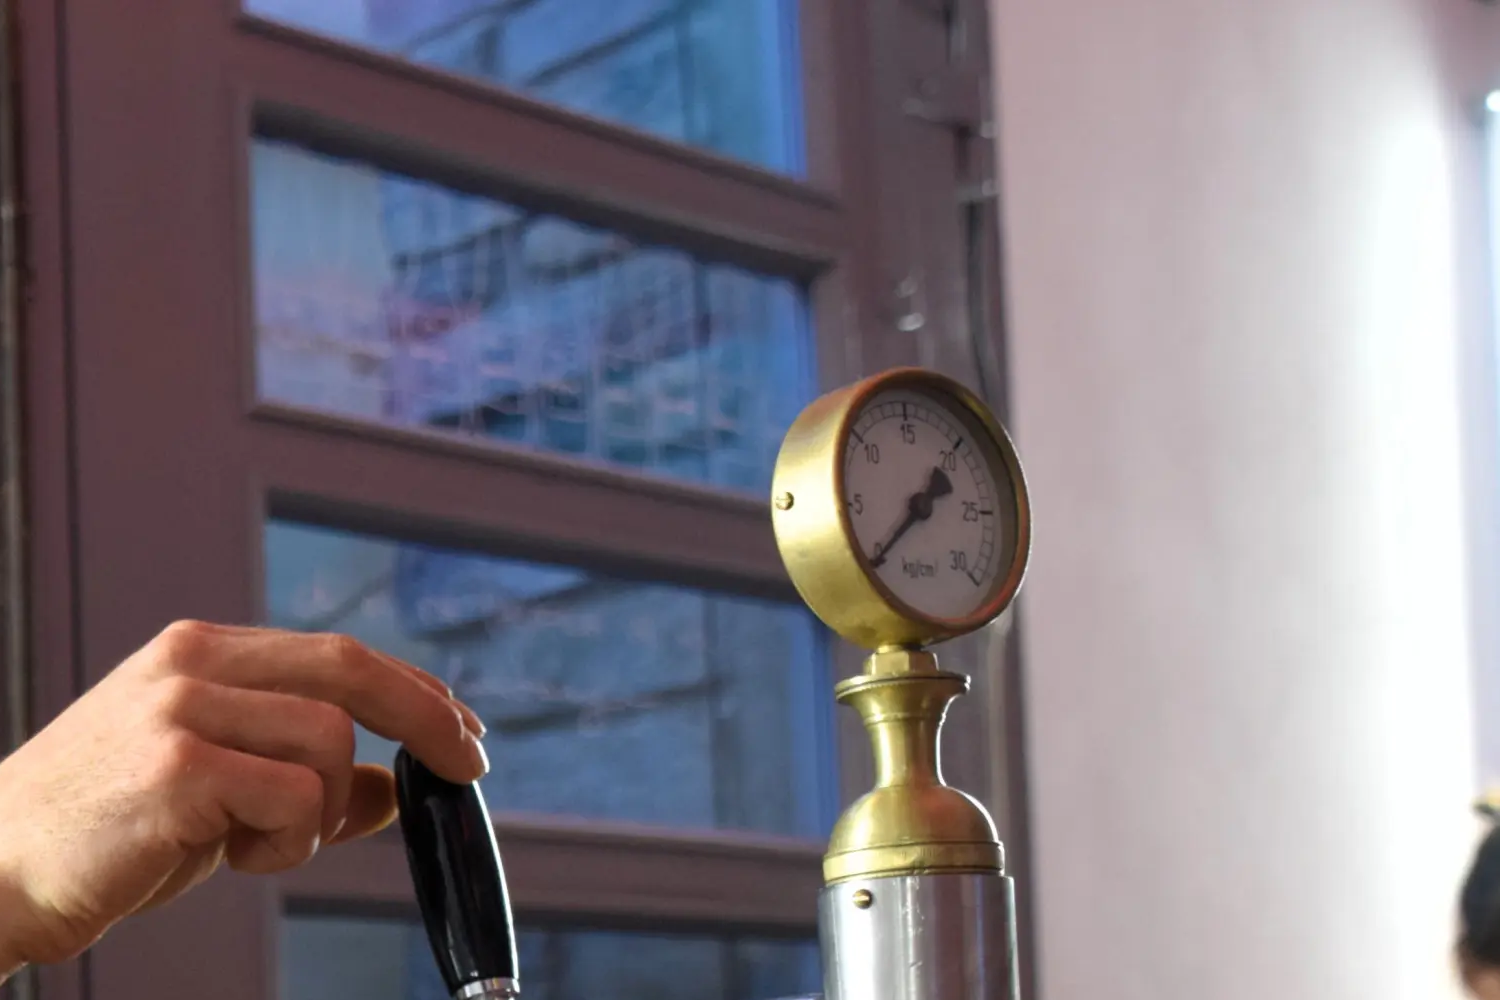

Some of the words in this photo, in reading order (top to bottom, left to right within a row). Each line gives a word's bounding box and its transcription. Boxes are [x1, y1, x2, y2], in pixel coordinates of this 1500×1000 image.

[900, 423, 916, 445] 15
[864, 444, 880, 465] 10
[939, 451, 957, 472] 20
[853, 494, 864, 516] 5
[962, 501, 979, 522] 25
[949, 550, 967, 572] 30
